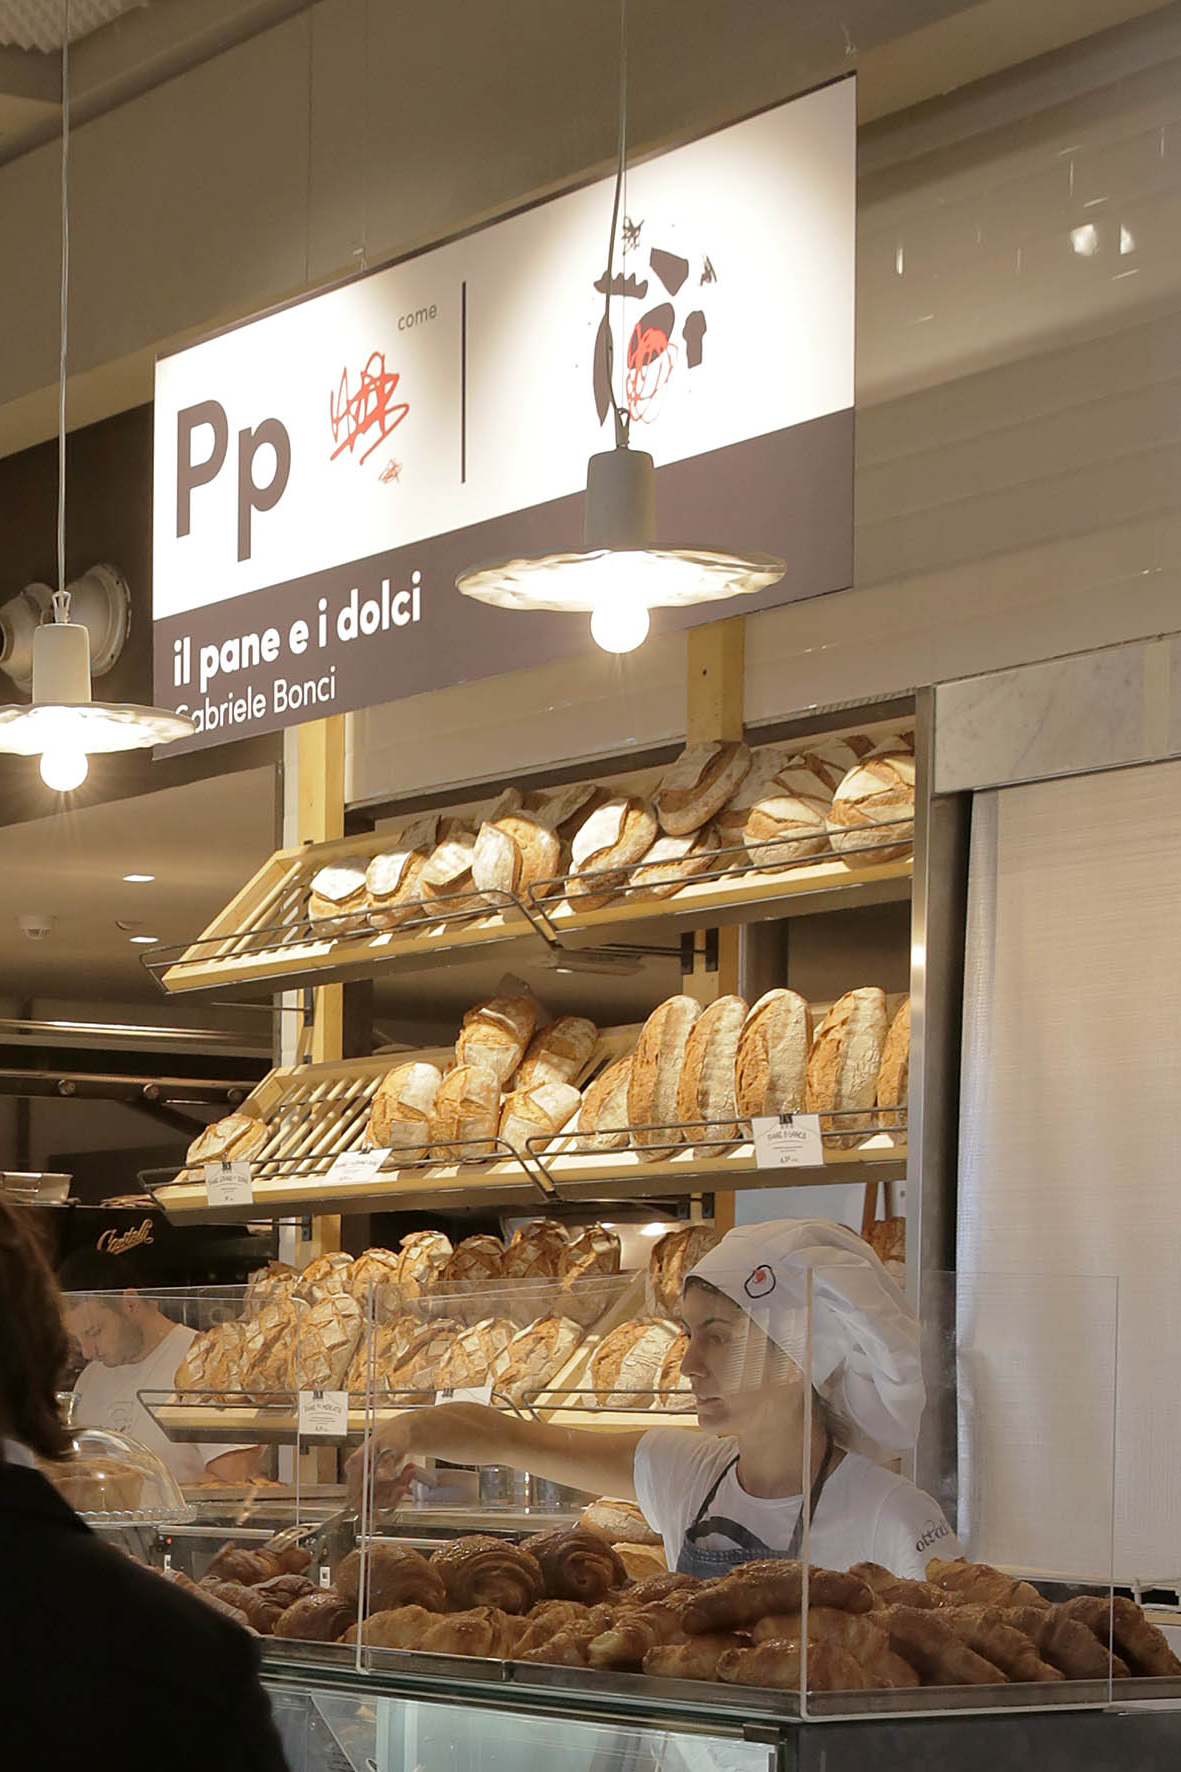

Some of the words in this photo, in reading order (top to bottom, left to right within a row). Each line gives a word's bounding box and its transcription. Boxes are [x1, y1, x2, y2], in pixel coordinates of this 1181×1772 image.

[397, 304, 437, 331] come
[176, 399, 292, 563] Pp
[173, 636, 191, 687] il
[199, 627, 281, 694] pane
[288, 619, 310, 655] e
[318, 597, 328, 648] i
[336, 569, 421, 642] dolci
[273, 664, 337, 714] Bonci
